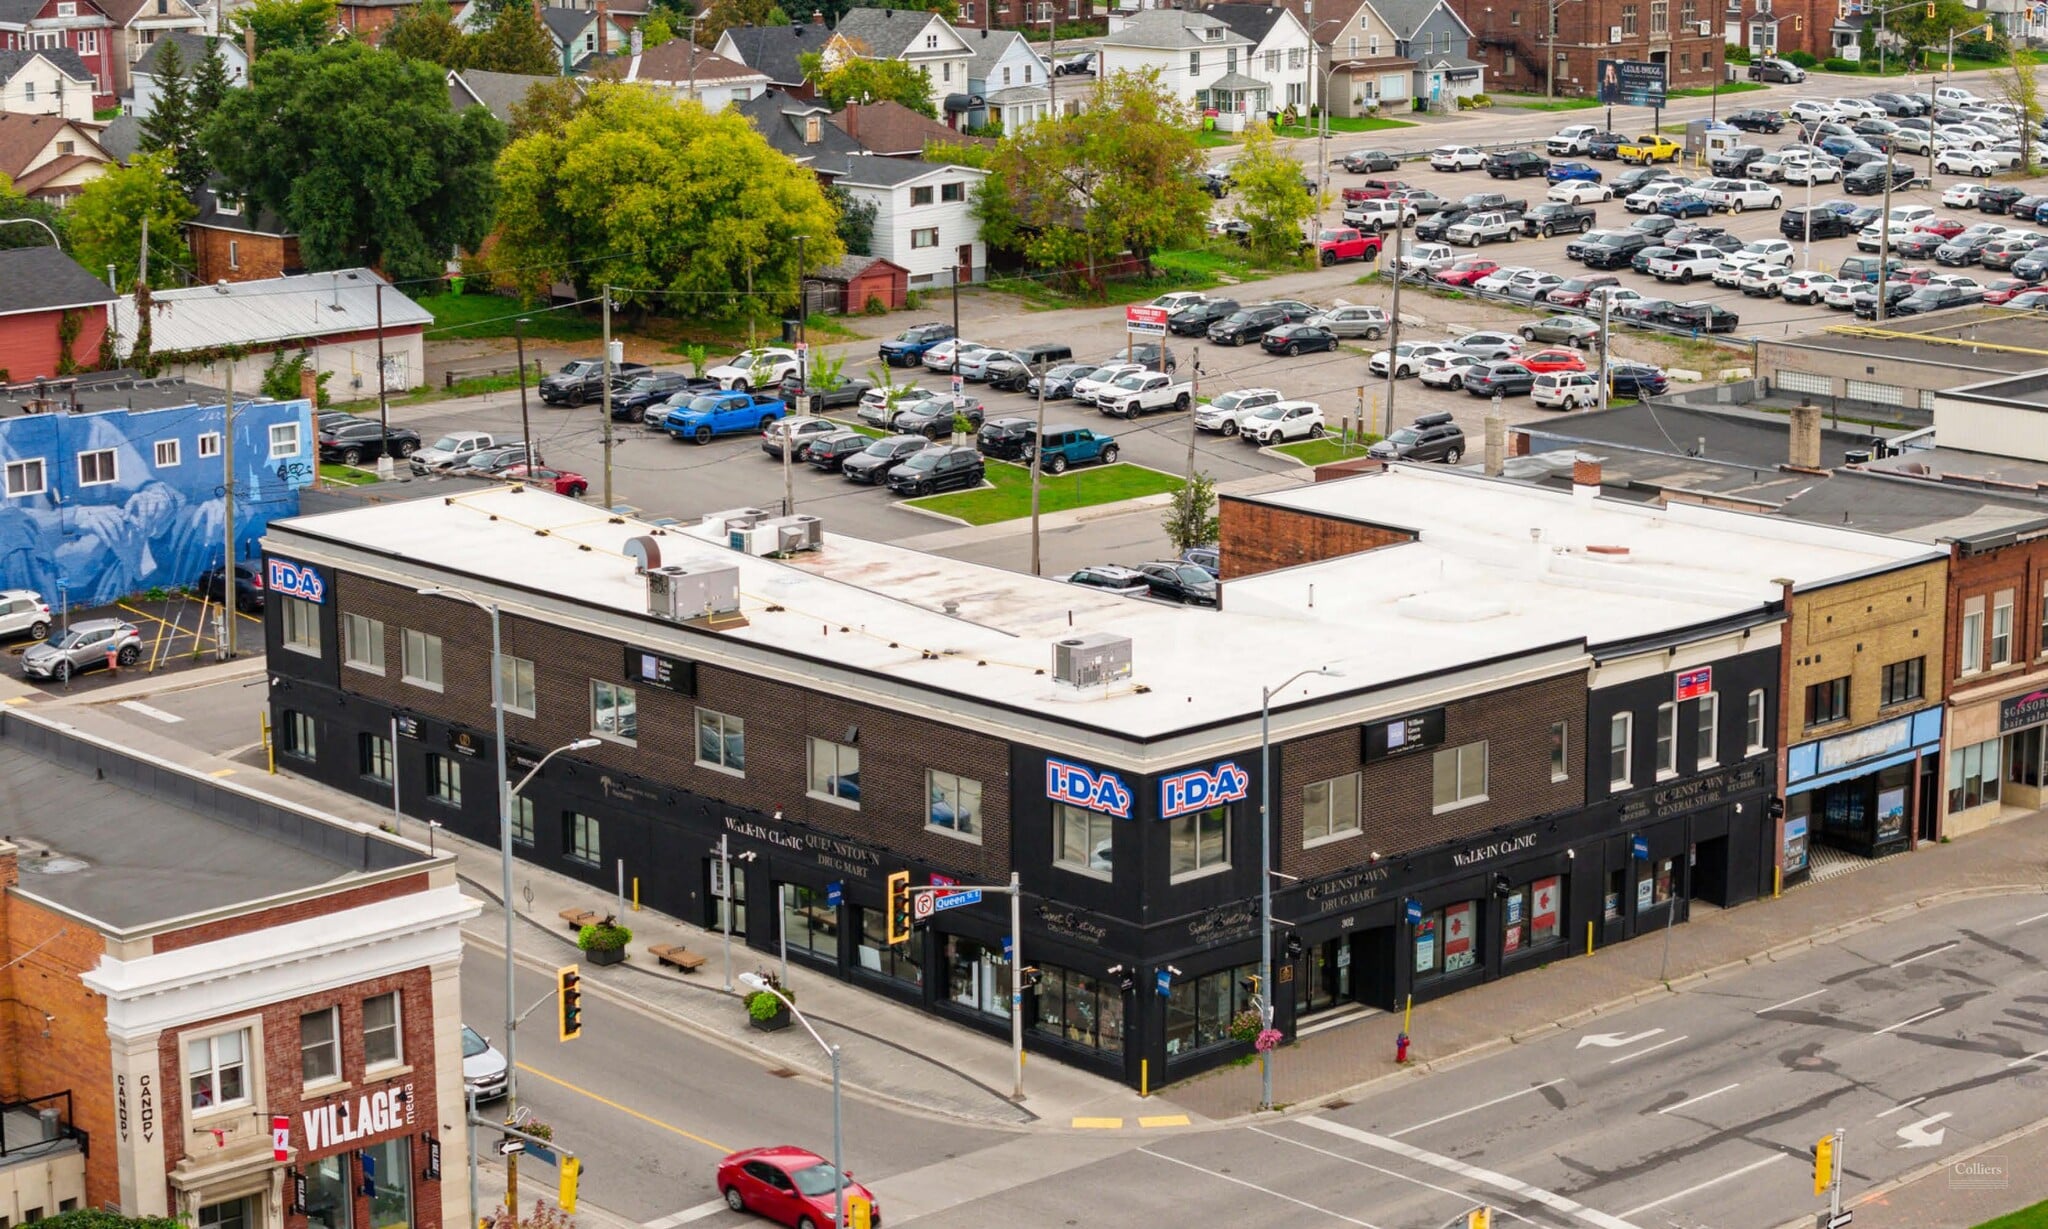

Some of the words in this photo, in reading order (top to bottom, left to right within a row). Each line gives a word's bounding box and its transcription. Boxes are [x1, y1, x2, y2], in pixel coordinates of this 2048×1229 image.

[2004, 718, 2023, 729] hair
[1655, 774, 1724, 805] QUENSTWN
[1695, 791, 1721, 806] STORE
[805, 833, 880, 866] QUENSTOWN
[818, 853, 843, 870] DRUG
[843, 861, 869, 879] MART
[936, 895, 966, 909] Queen
[1321, 895, 1349, 913] DRUG
[1349, 887, 1377, 904] MART
[1341, 916, 1354, 929] 302
[117, 1074, 128, 1143] CANOPY
[140, 1074, 153, 1143] CANOPY
[303, 1086, 403, 1152] VILLAGE
